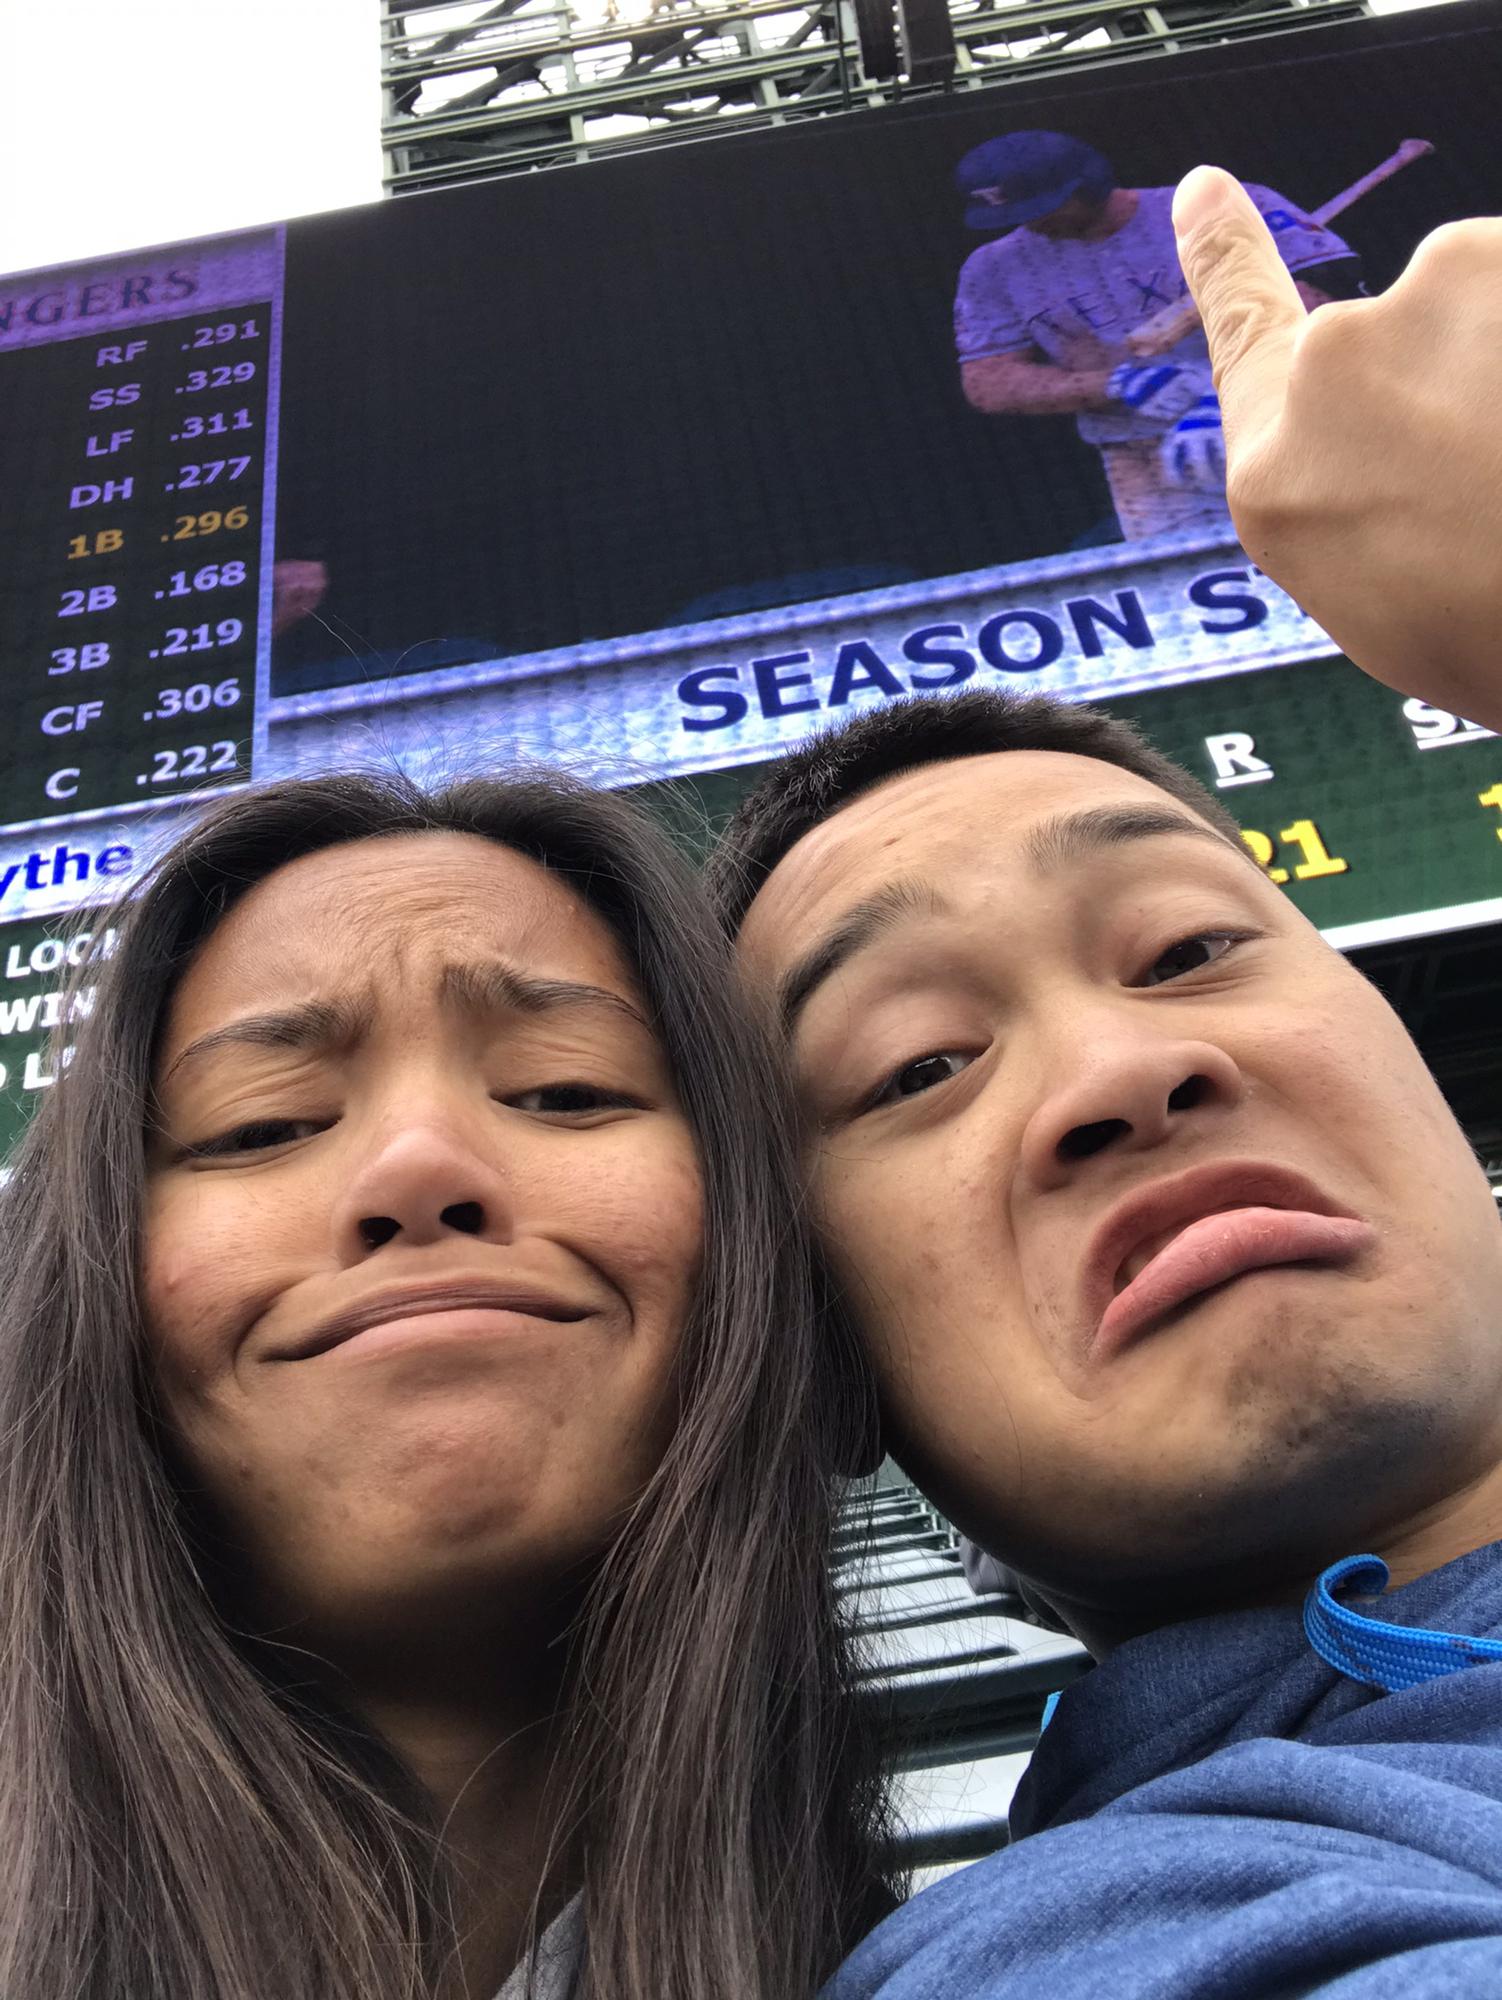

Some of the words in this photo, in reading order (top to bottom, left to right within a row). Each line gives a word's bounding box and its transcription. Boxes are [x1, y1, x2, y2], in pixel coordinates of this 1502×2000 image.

[1027, 271, 1190, 338] TEX
[97, 340, 148, 367] RF
[181, 319, 260, 350] .291
[89, 383, 141, 410] SS
[175, 361, 256, 394] .329
[86, 429, 134, 458] LF
[170, 408, 253, 442] .311
[69, 477, 134, 509] DH
[165, 456, 251, 492] .277
[68, 529, 124, 559] 1B
[161, 506, 249, 542] .296
[58, 585, 117, 617] 2B
[155, 560, 246, 600] .168
[48, 642, 111, 675] 3B
[149, 618, 243, 659] .219
[677, 590, 1155, 734] SEASON
[1188, 569, 1276, 635] S
[40, 701, 104, 735] CF
[143, 678, 240, 721] .306
[45, 768, 80, 799] C
[136, 740, 237, 785] .222
[1206, 732, 1272, 780] R
